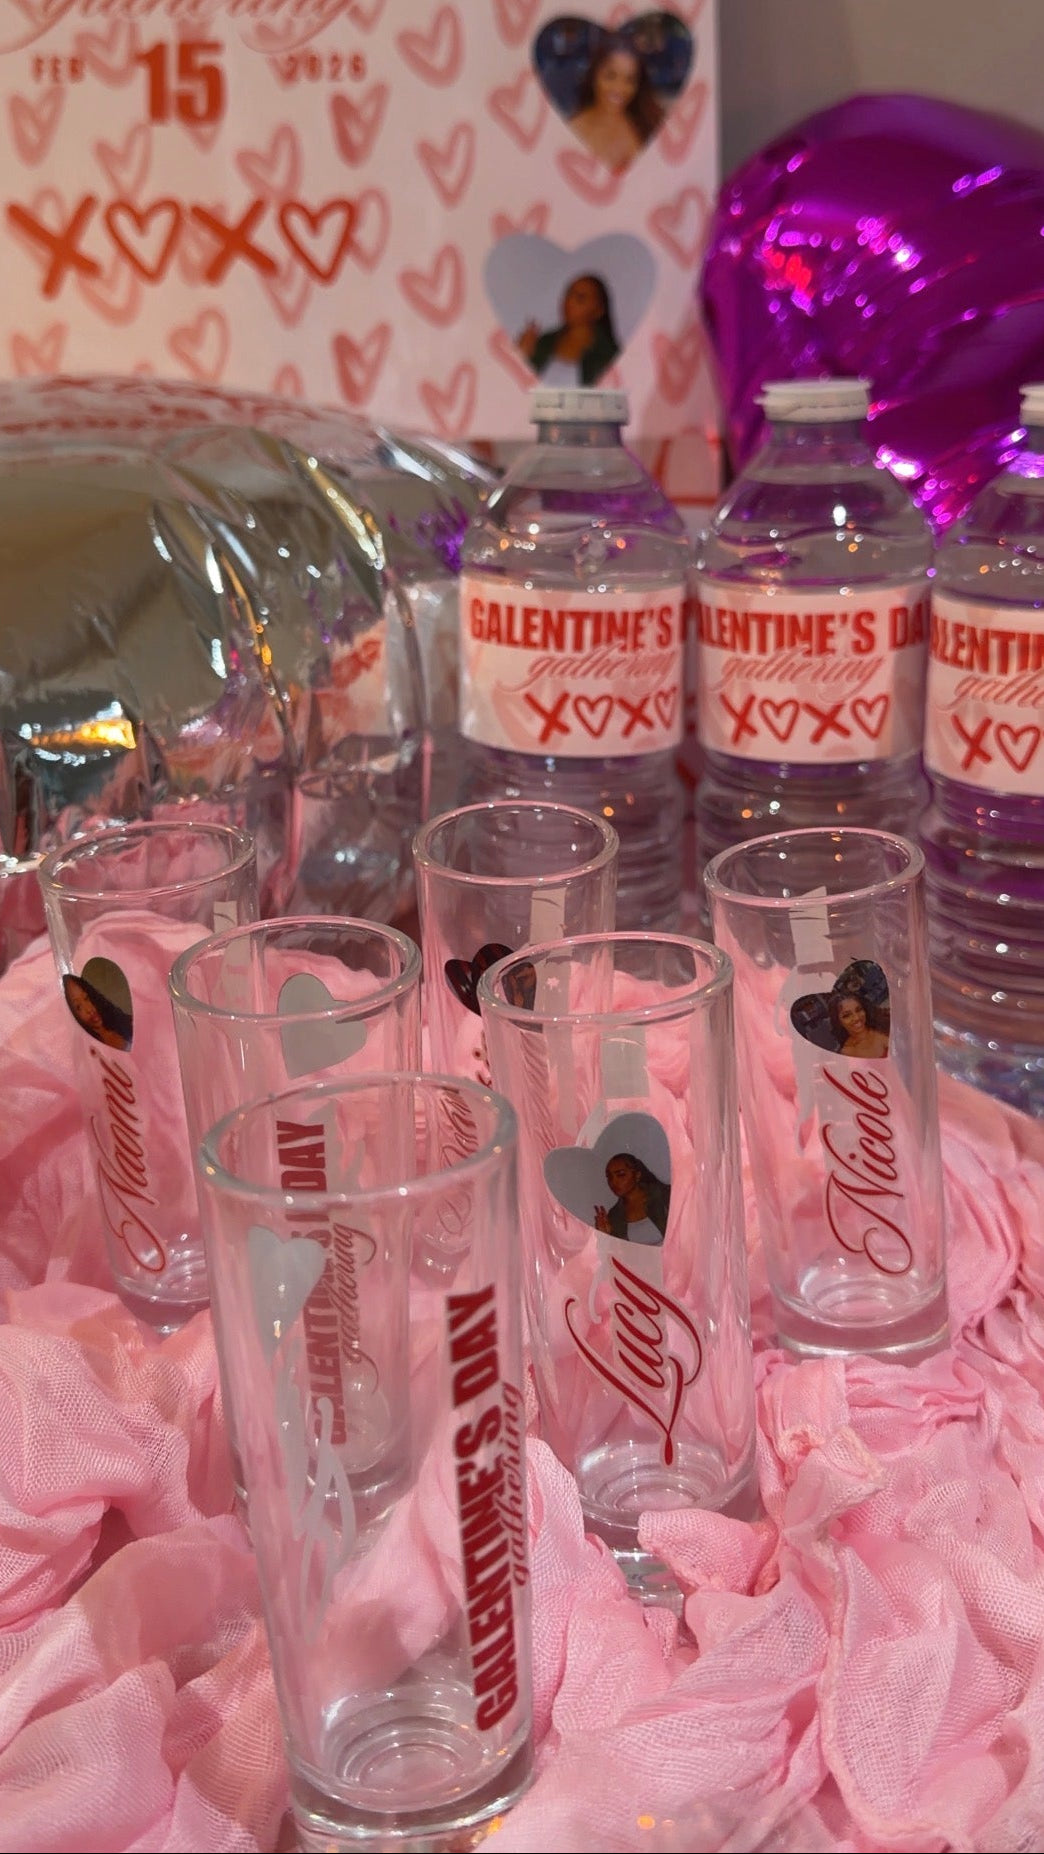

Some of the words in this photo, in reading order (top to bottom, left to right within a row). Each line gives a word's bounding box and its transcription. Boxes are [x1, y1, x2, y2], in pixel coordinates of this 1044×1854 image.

[135, 41, 225, 126] 15
[470, 597, 674, 654] GALENTINE'S
[91, 1046, 166, 1273] Naomi
[276, 1120, 329, 1222] DAY
[823, 1067, 913, 1274] Nicole
[446, 1282, 500, 1409] DAY
[565, 1256, 703, 1466] Lucy
[455, 1404, 518, 1732] GALENTINE'S
[492, 1380, 530, 1586] gathering
